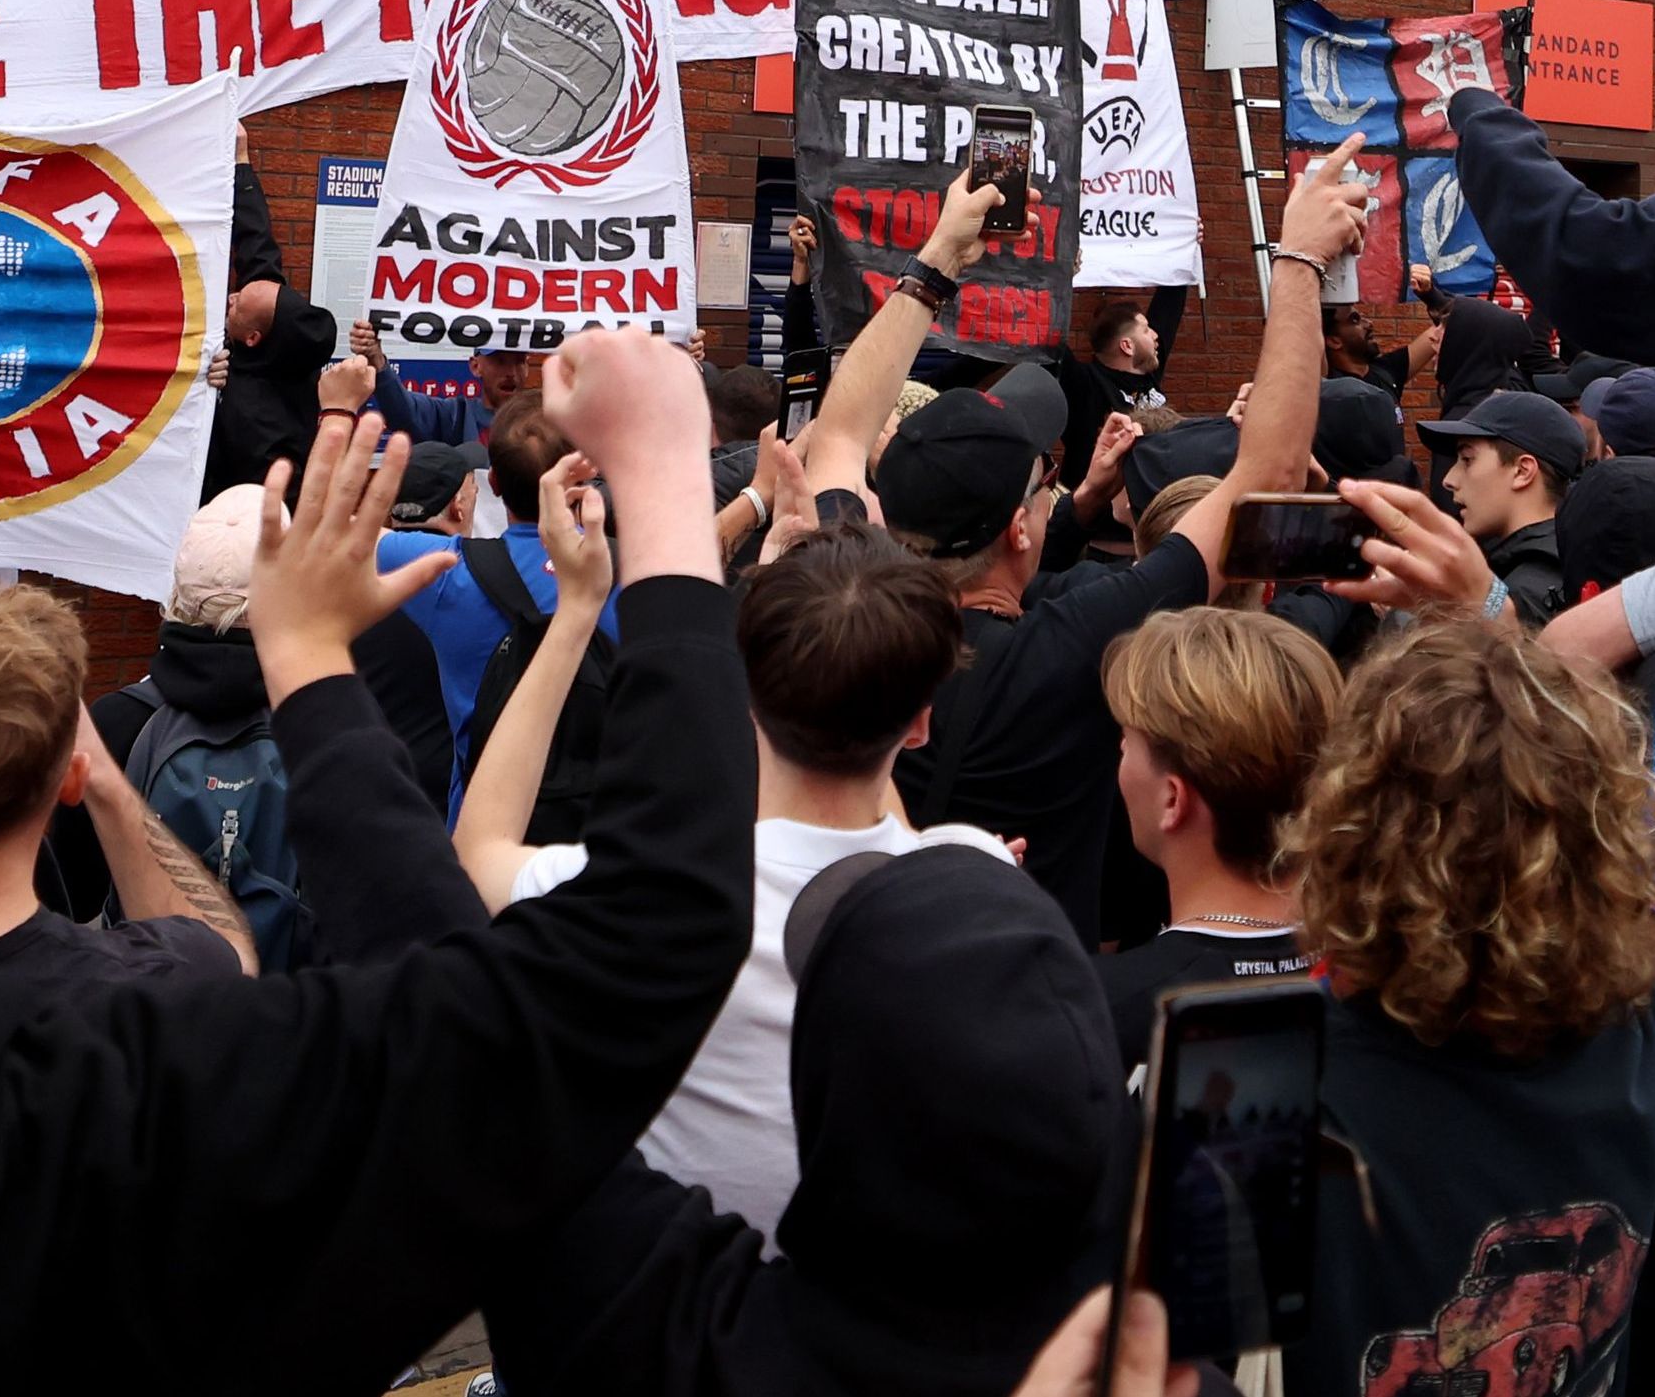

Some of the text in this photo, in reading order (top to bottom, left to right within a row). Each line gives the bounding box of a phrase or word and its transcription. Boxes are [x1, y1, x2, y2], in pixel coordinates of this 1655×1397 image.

[815, 15, 1064, 97] CREATED BY
[1536, 34, 1620, 59] ANDARD
[1528, 60, 1620, 86] NTRANCE
[838, 98, 1056, 183] THE PR,
[1088, 106, 1141, 148] UEFA
[327, 181, 383, 199] REGULAT
[328, 165, 383, 183] STADIUM
[1080, 169, 1176, 199] RUPTION
[377, 204, 676, 262] AGAINST
[371, 255, 678, 313] MODERN
[368, 309, 666, 349] FOOTB
[956, 282, 1062, 347] RICH.
[1234, 961, 1276, 975] CRYSTAL
